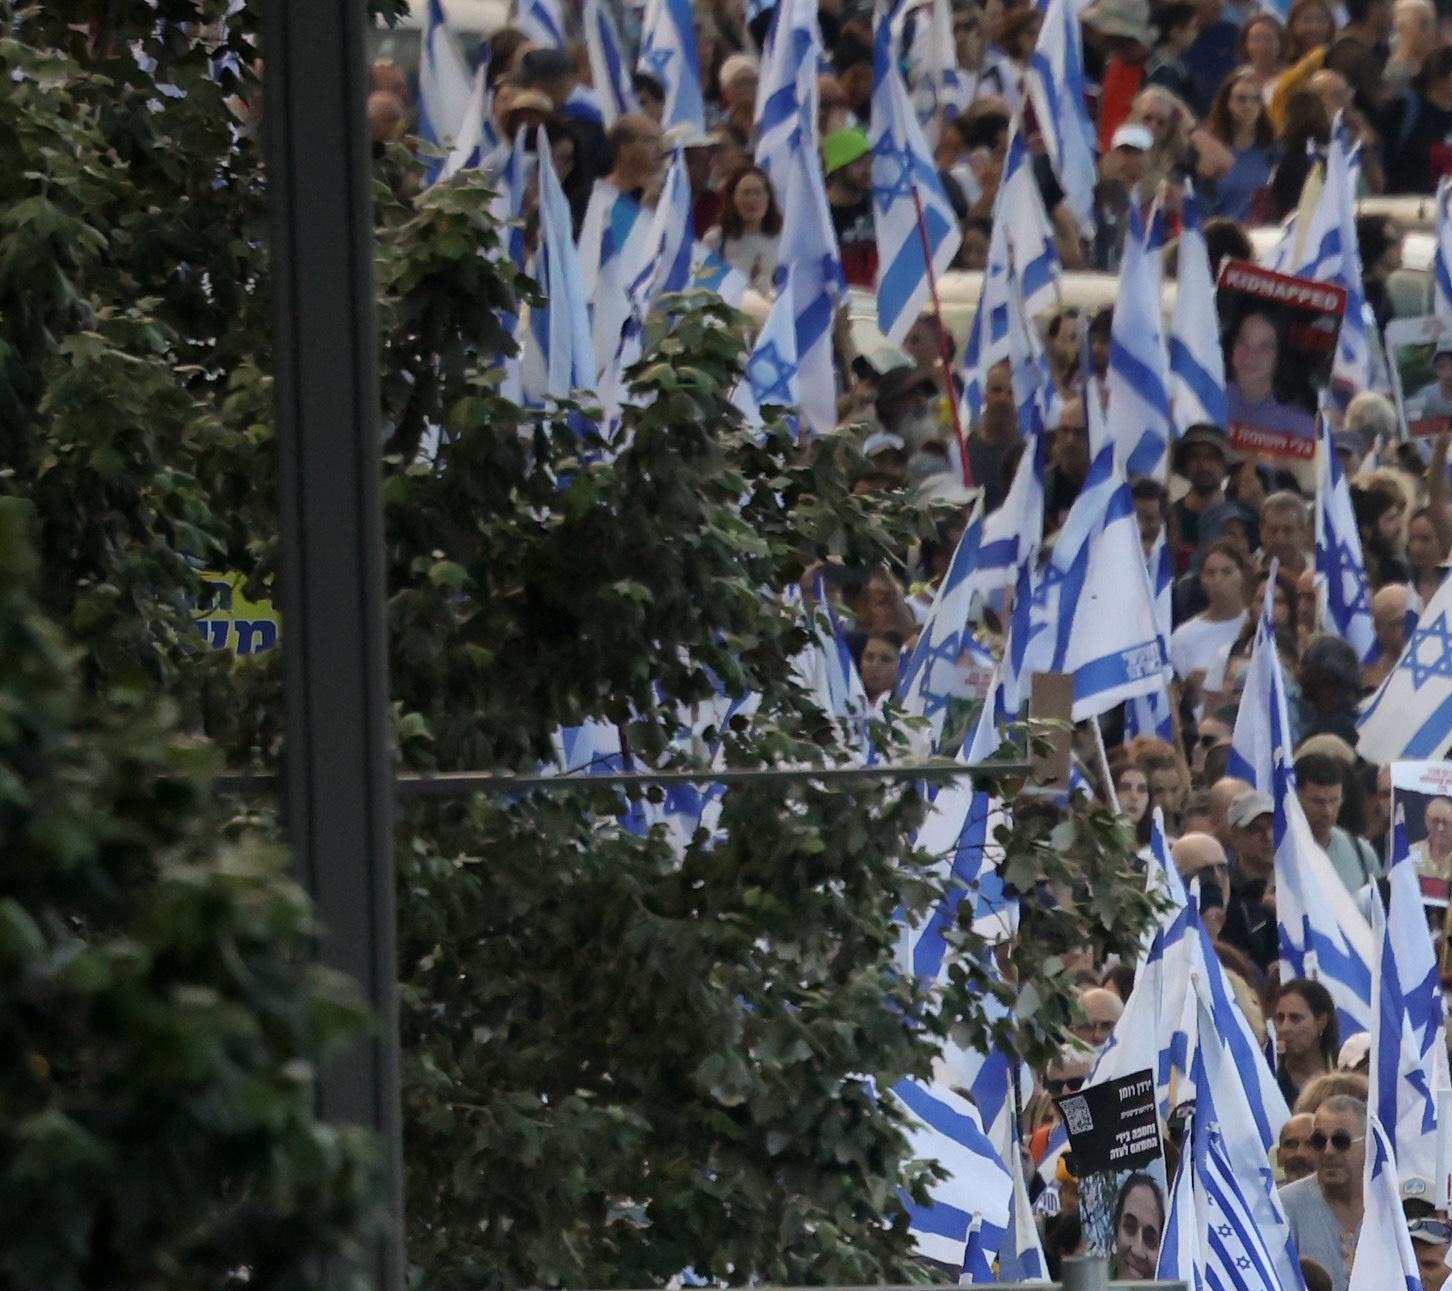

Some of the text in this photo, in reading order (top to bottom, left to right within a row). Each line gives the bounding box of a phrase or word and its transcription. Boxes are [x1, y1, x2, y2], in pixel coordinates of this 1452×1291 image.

[1225, 269, 1339, 312] KIDNAPPED
[1118, 1080, 1151, 1100] ירדן רומן
